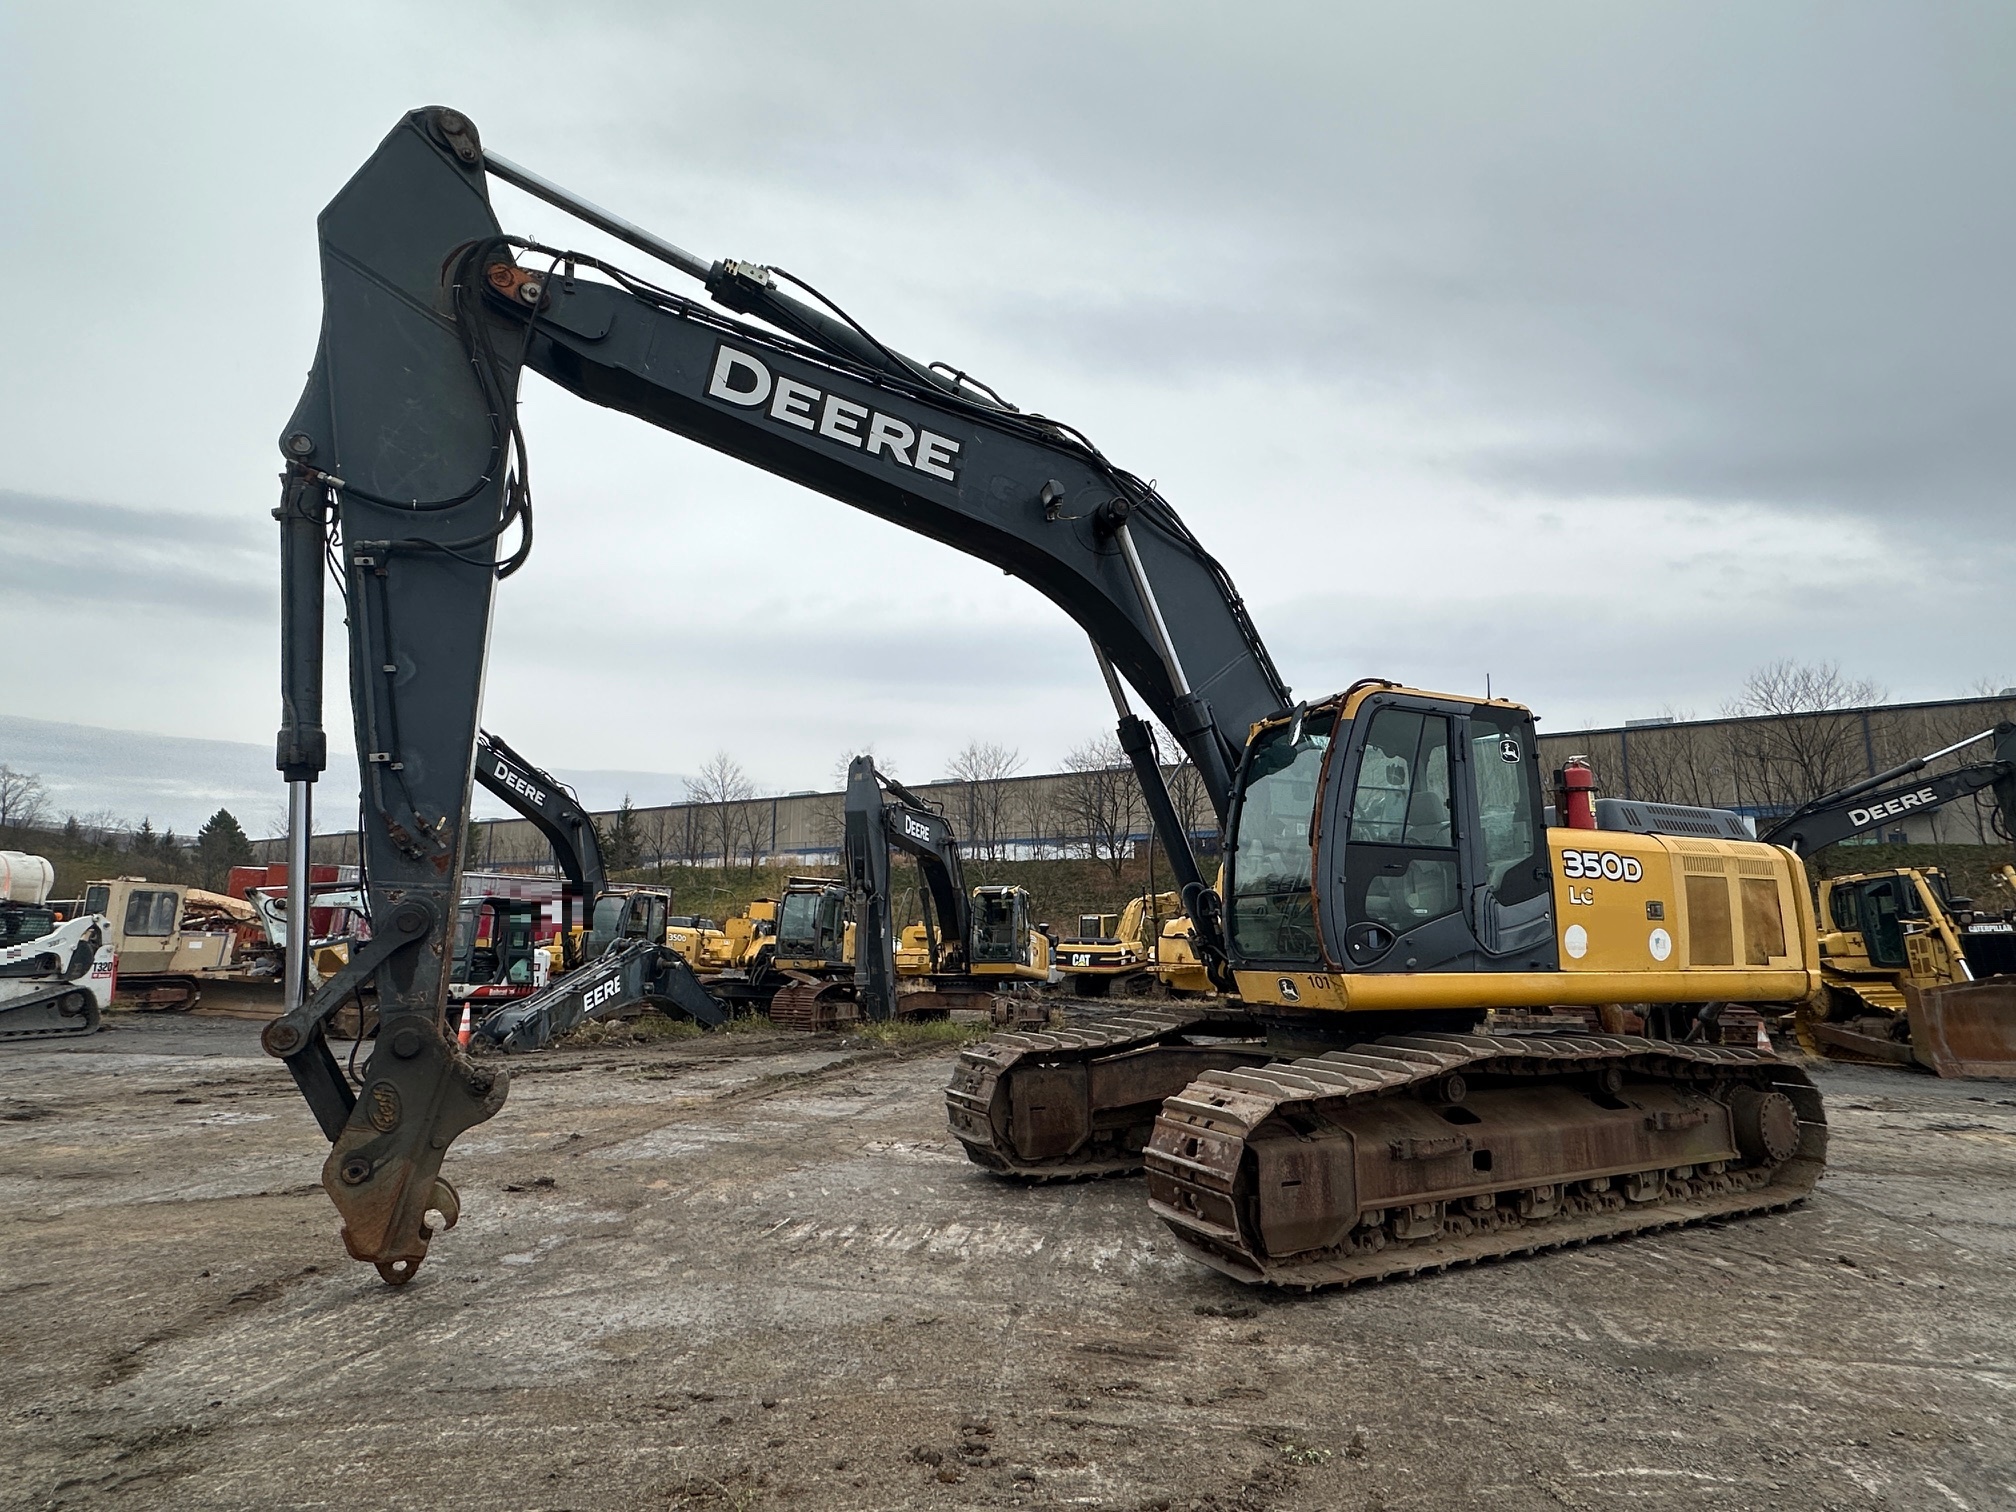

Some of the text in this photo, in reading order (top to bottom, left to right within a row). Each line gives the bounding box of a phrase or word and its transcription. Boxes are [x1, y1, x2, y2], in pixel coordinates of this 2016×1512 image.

[709, 344, 960, 482] DEERE
[493, 760, 546, 807] DEERE
[1847, 786, 1938, 827] DEERE
[905, 814, 930, 842] DEERE
[1561, 849, 1643, 883] 350D
[1568, 885, 1593, 906] LC
[1968, 924, 2014, 933] CATERPILLAR
[93, 961, 113, 972] T320
[1072, 953, 1091, 967] CAT
[1307, 974, 1331, 990] 101
